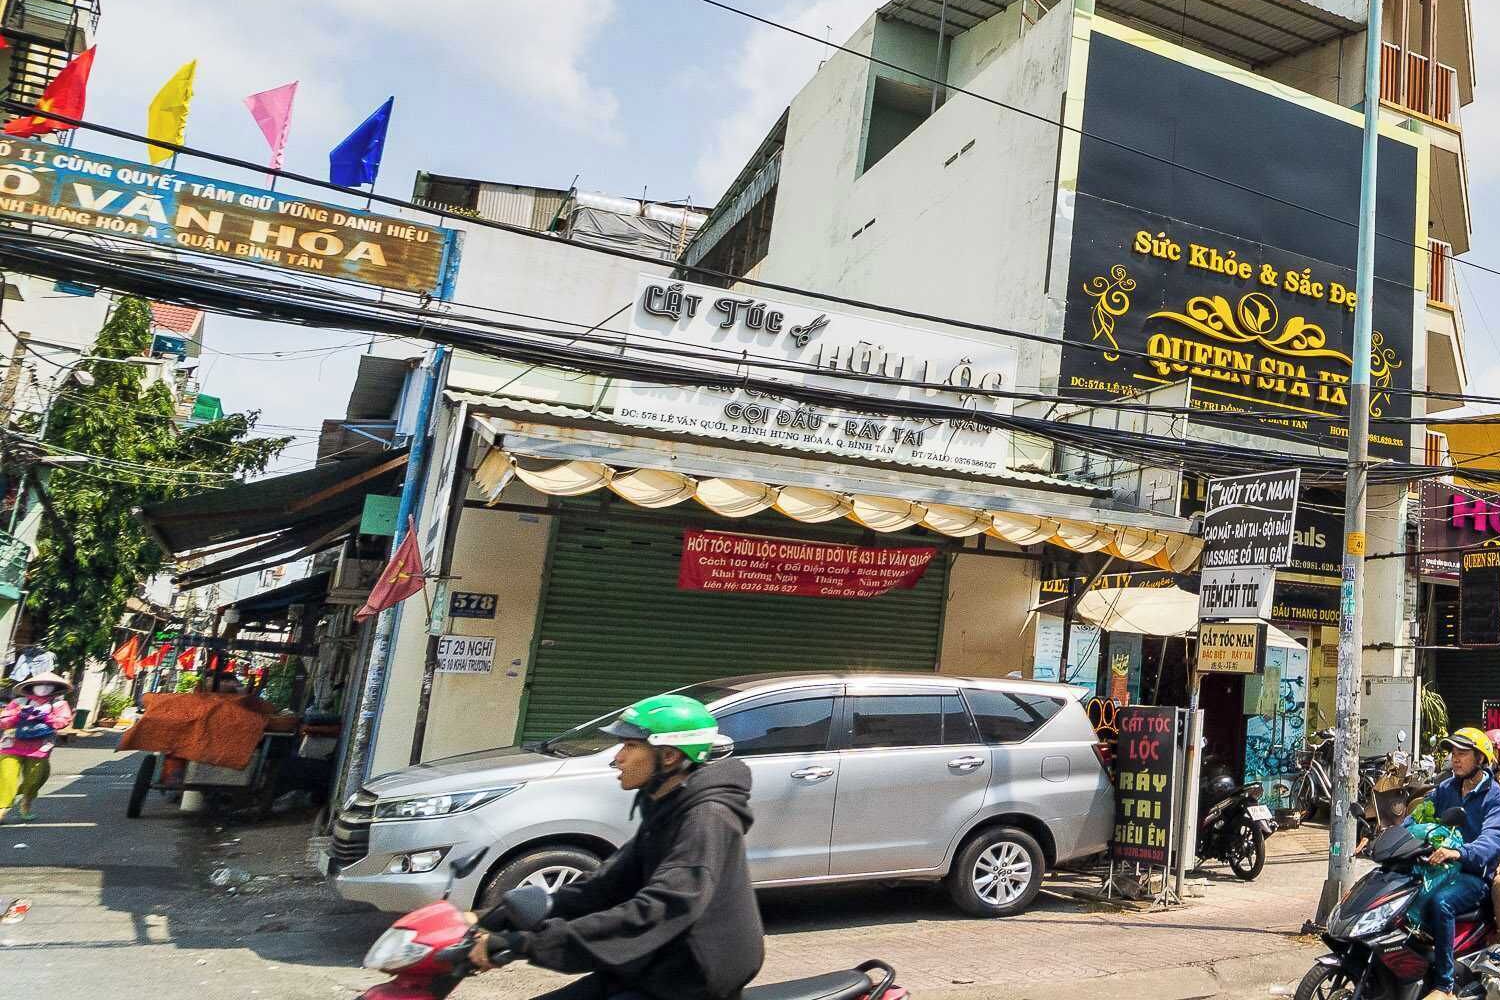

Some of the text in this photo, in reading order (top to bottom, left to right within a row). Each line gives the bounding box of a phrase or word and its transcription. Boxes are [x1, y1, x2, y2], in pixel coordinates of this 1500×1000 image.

[19, 148, 429, 243] 11 CÙNG QUYẾT TÂM GIỮ VỮNG DANH HIỆU
[31, 202, 324, 270] HƯNG HÒA A QUẬN BÌNH TÂN
[72, 182, 226, 234] VĂN
[249, 228, 388, 267] HÓA
[1135, 230, 1358, 313] Sức Khỏe & Sắc Đẹ
[1147, 333, 1255, 385] QUEEN
[1257, 356, 1311, 398] SPA
[641, 412, 658, 421] 578
[660, 413, 674, 424] LÊ
[676, 416, 698, 427] VĂN
[844, 420, 886, 440] RÁY
[892, 426, 924, 447] TAI
[1219, 481, 1244, 506] HỚT
[1245, 479, 1267, 503] TÓC
[1266, 479, 1294, 501] NAM
[1205, 526, 1217, 544] CẠO
[1235, 519, 1249, 538] RÁY
[1249, 522, 1259, 537] TAI
[699, 556, 726, 566] Cách
[730, 559, 747, 567] 100
[709, 535, 732, 553] TÓC
[733, 539, 755, 556] HỮU
[756, 541, 777, 560] LỘC
[859, 553, 874, 565] 431
[878, 550, 887, 565] LÊ
[889, 550, 908, 566] VĂN
[1254, 547, 1267, 563] VAI
[1270, 543, 1288, 563] GÁY
[1463, 552, 1486, 570] QUEEN
[1487, 551, 1500, 567] SPA
[712, 568, 735, 578] Khai
[775, 573, 799, 584] Ngày
[815, 575, 844, 586] Tháng
[454, 594, 494, 610] 578
[1203, 572, 1259, 613] TIỆM CẮT TÓC
[1292, 607, 1317, 620] THANG
[453, 640, 465, 655] 29
[1219, 631, 1235, 647] TÓC
[1236, 634, 1254, 647] NAM
[1121, 712, 1172, 734] CẮT TÓC
[1129, 735, 1160, 766] LỘC
[1119, 768, 1168, 793] RÁY
[1147, 824, 1167, 848] ÊM
